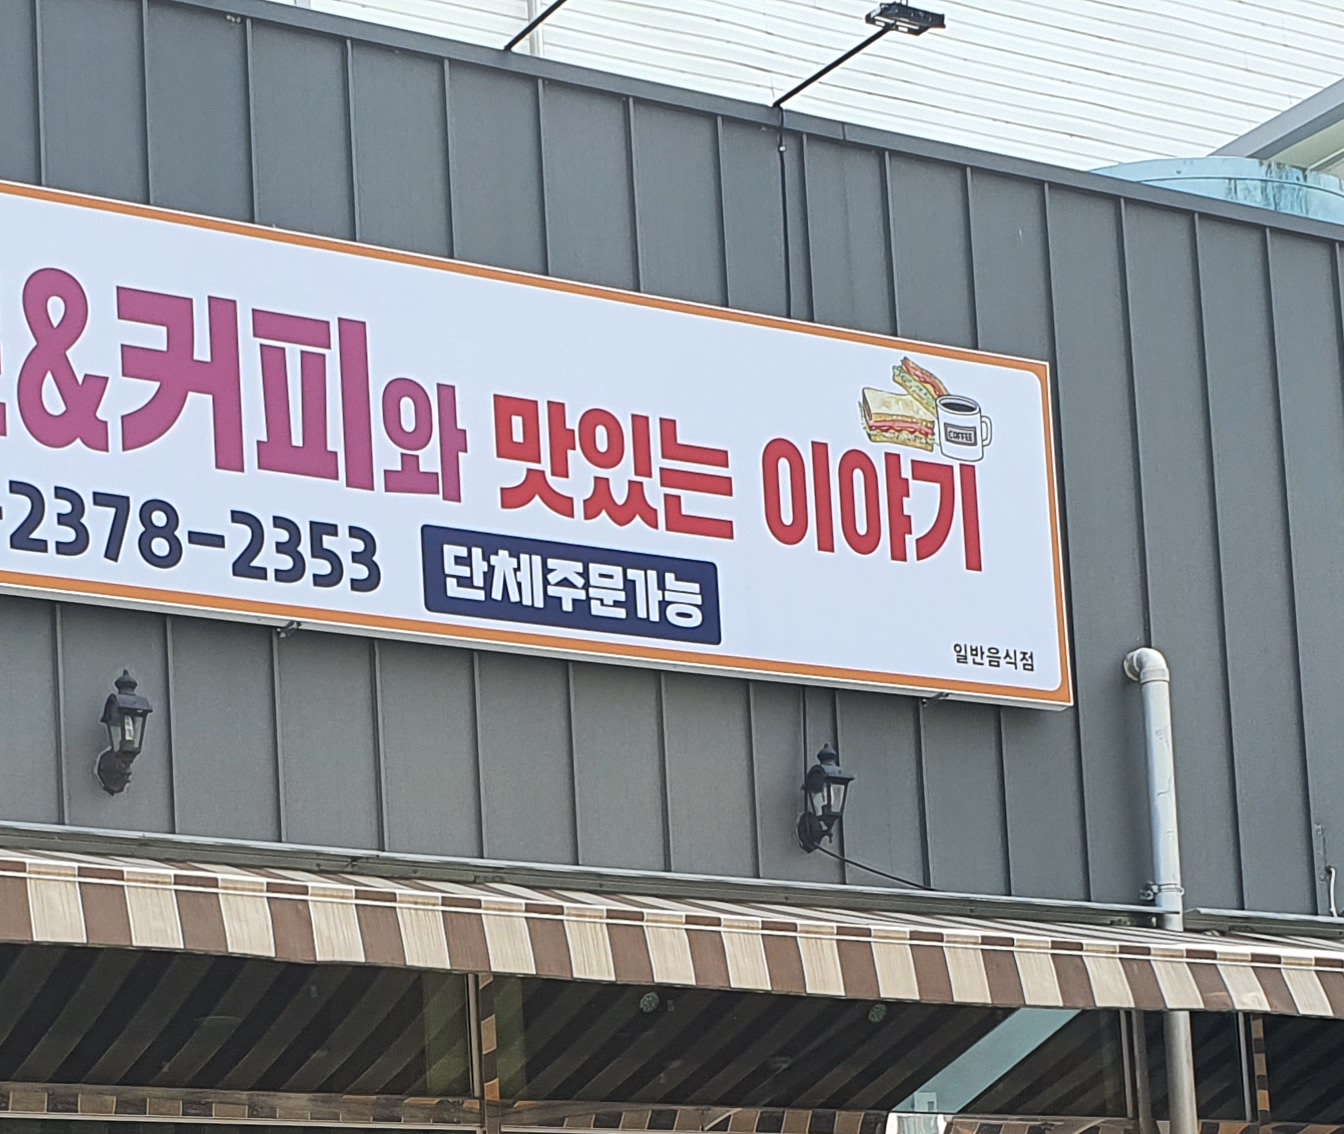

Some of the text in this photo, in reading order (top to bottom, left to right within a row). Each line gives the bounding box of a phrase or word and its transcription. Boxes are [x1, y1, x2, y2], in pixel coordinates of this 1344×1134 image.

[948, 430, 973, 442] COFFEE
[493, 392, 735, 540] 맛있는
[762, 436, 983, 572] 이야기
[442, 540, 704, 630] 단체주문가능
[953, 643, 1035, 672] 일반음식점
